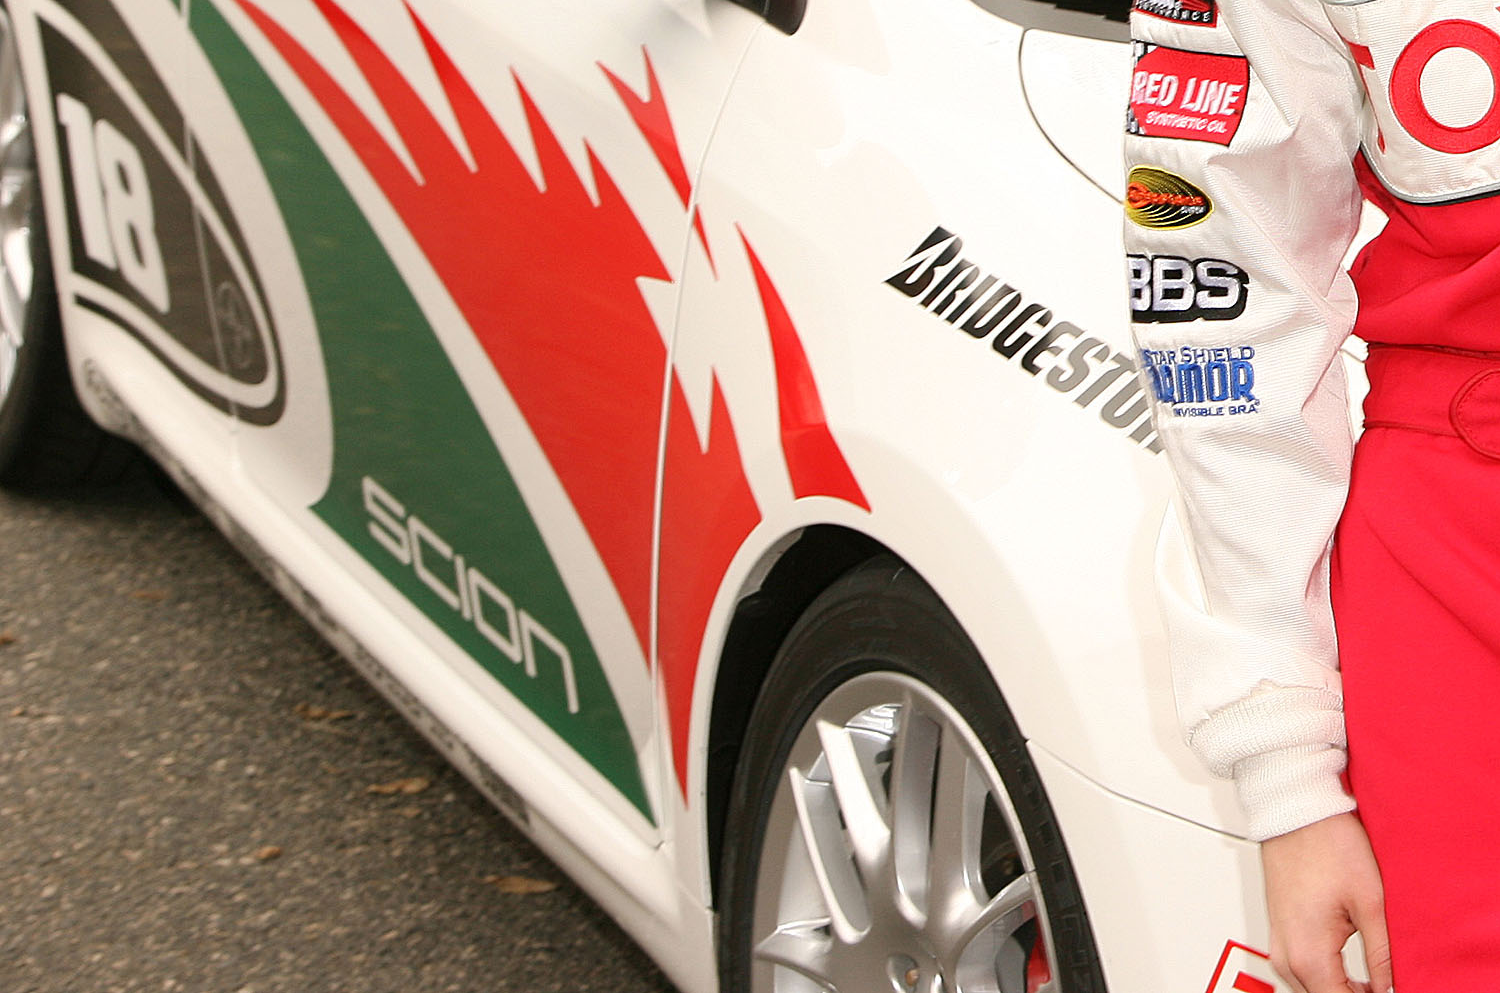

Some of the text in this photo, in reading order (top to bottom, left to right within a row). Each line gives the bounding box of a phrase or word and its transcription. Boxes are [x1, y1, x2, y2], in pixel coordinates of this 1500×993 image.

[1132, 70, 1244, 116] RED LINE
[1146, 110, 1206, 131] SYNTHETIC
[56, 93, 170, 313] 18
[1127, 257, 1242, 312] BBS
[1179, 346, 1255, 364] SHIELD
[362, 477, 580, 715] SCION
